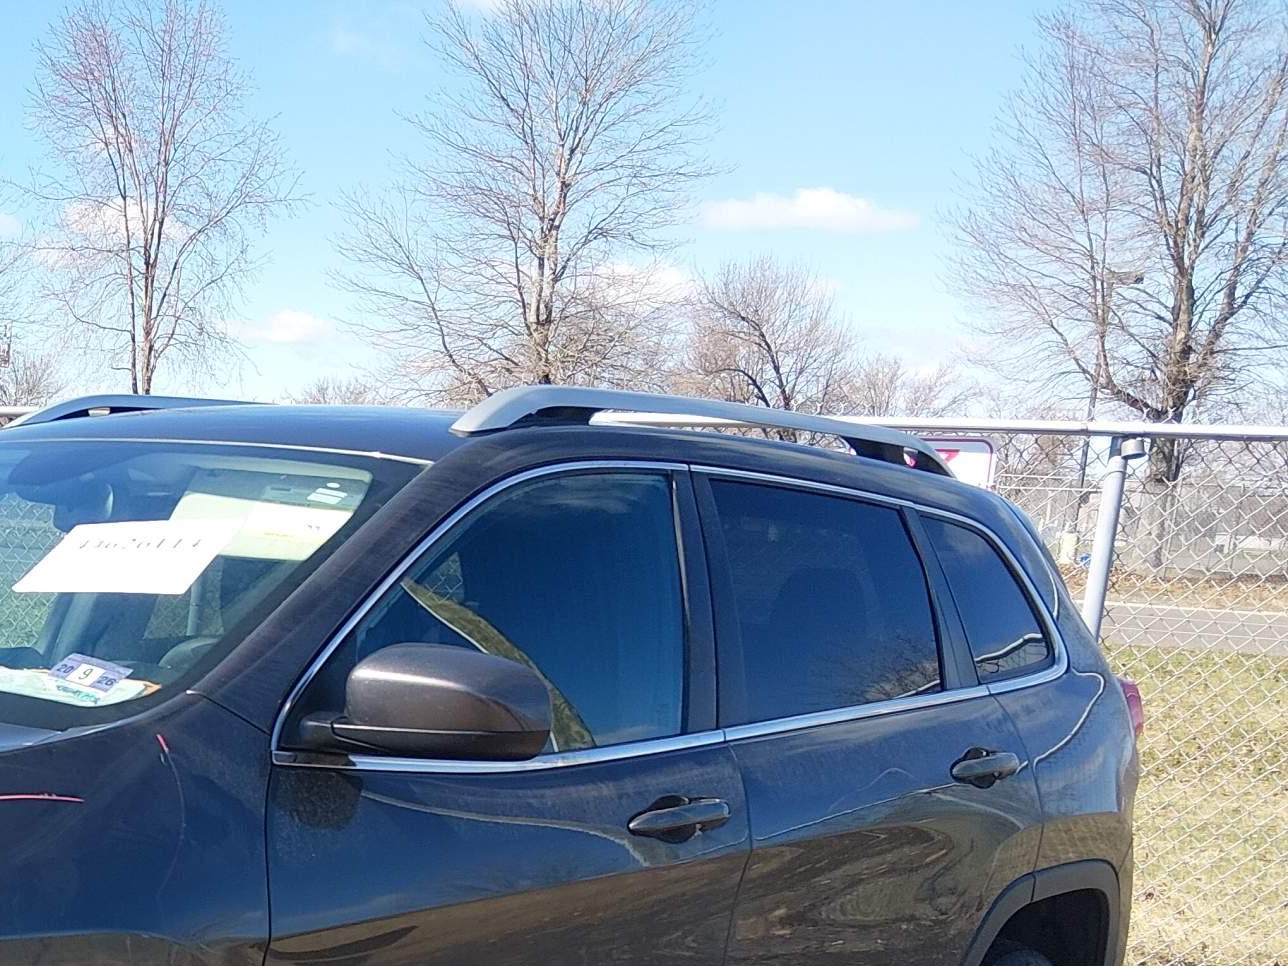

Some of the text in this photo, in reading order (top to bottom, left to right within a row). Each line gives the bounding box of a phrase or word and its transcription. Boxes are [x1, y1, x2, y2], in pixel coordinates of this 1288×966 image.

[57, 663, 116, 686] 20 9 26
